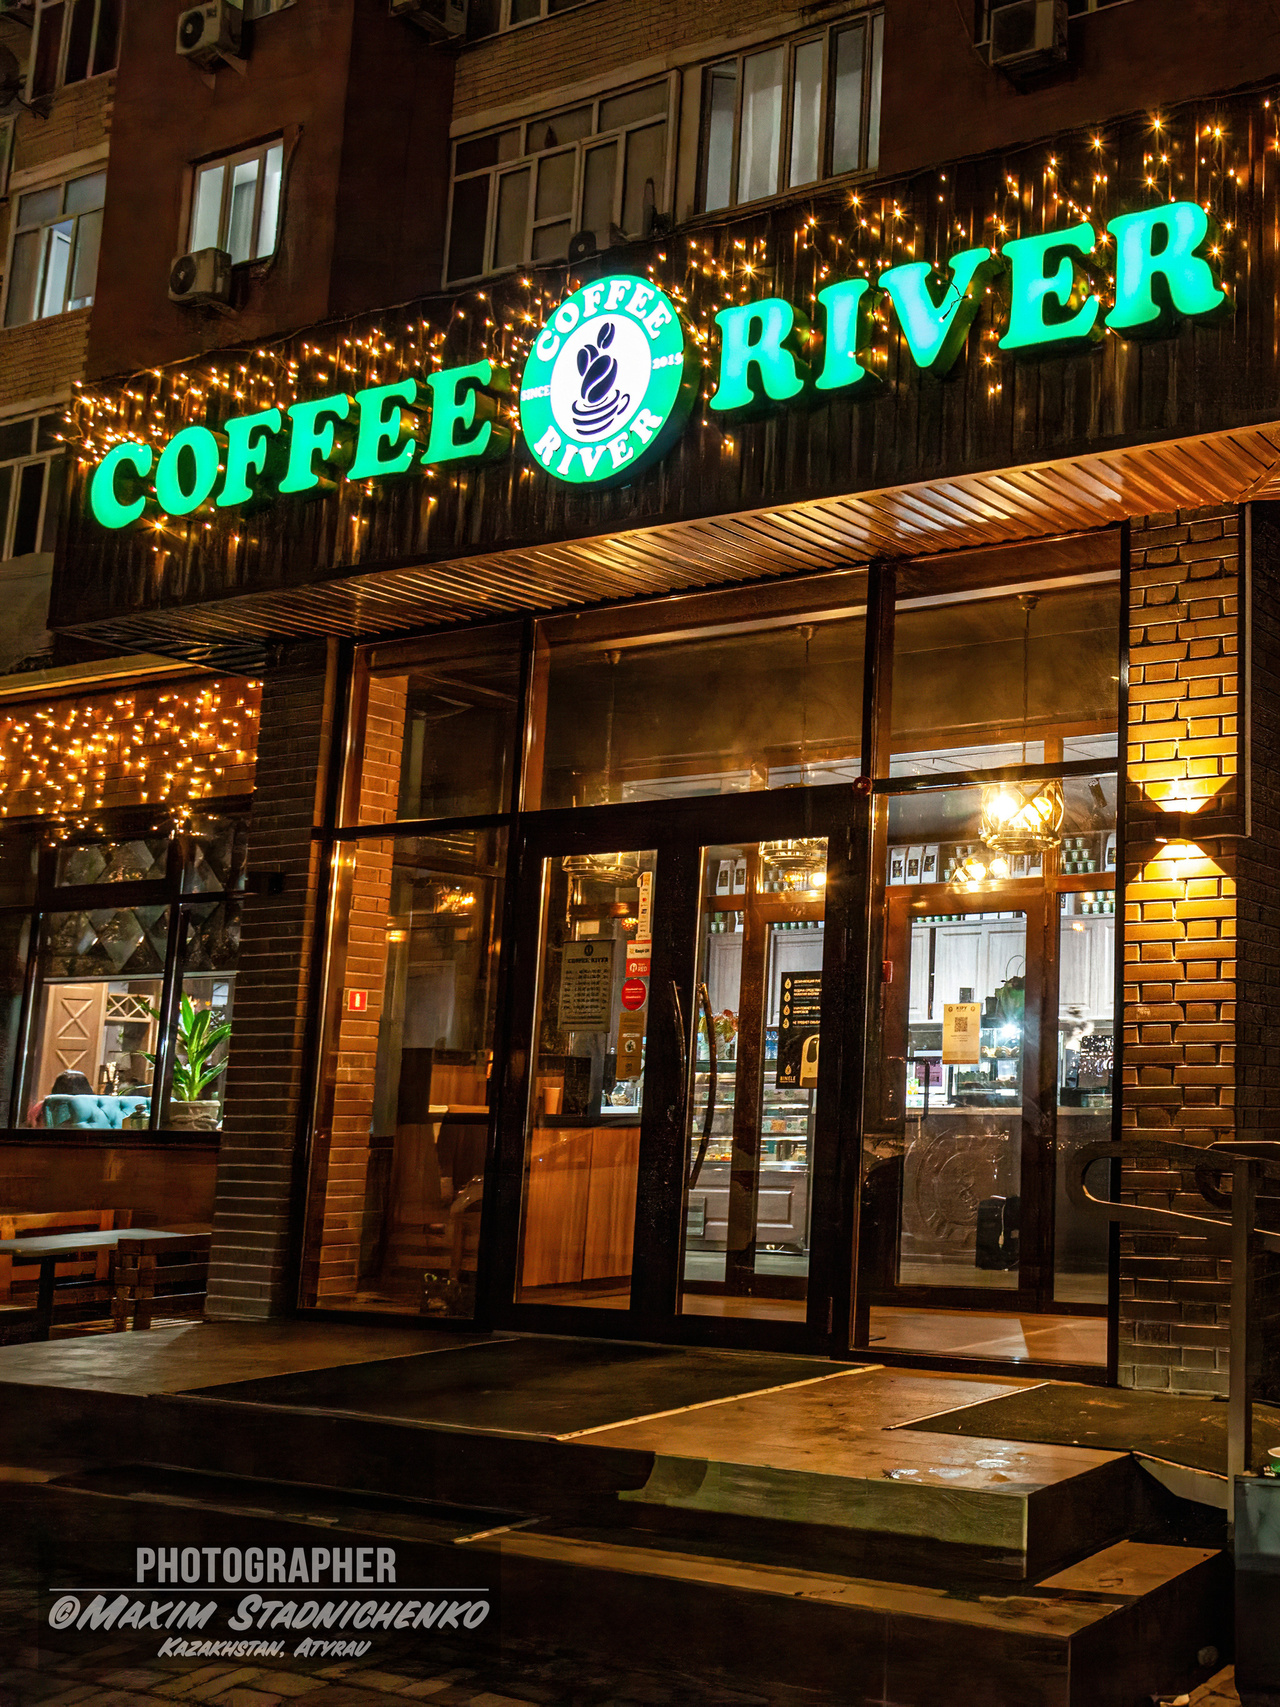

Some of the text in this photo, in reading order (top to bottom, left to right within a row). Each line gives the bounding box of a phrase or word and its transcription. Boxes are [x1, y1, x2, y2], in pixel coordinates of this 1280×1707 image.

[536, 279, 673, 362] COFFEE
[91, 201, 1226, 529] COFFEE RIVER
[521, 385, 551, 402] SINCE
[533, 407, 664, 478] RIVER
